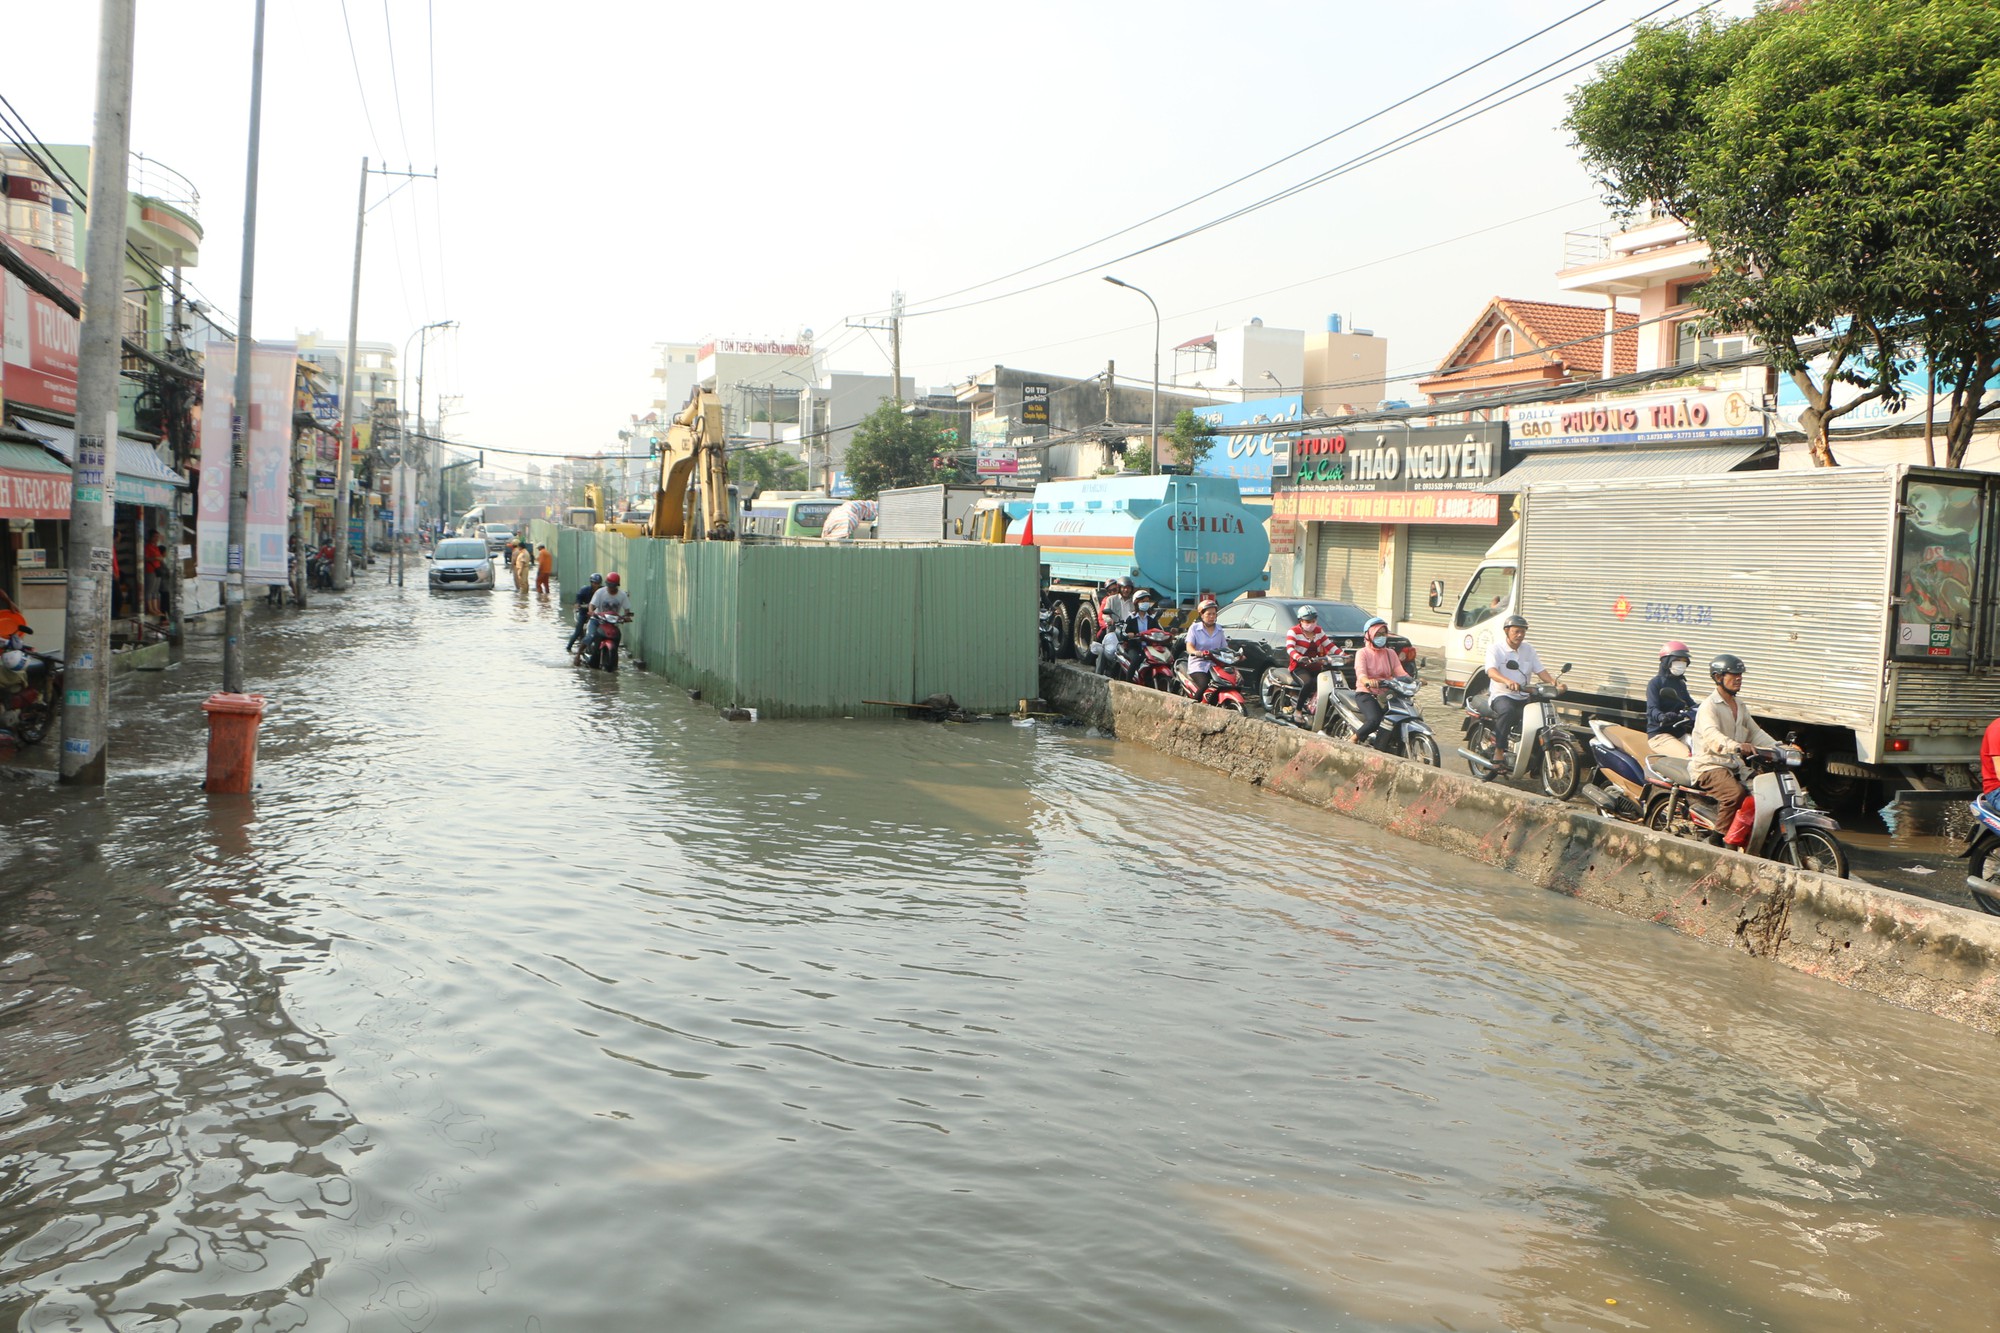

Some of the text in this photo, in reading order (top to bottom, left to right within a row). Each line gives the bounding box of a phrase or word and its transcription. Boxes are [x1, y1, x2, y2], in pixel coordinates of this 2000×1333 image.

[1560, 397, 1710, 433] PHƯƠNG THẢO
[1521, 421, 1553, 438] GẠO
[1296, 435, 1345, 455] STUDIO
[1349, 434, 1493, 480] THẢO NGUYÊN
[1167, 511, 1245, 534] CẤM LỬA
[1931, 632, 1950, 642] CRB
